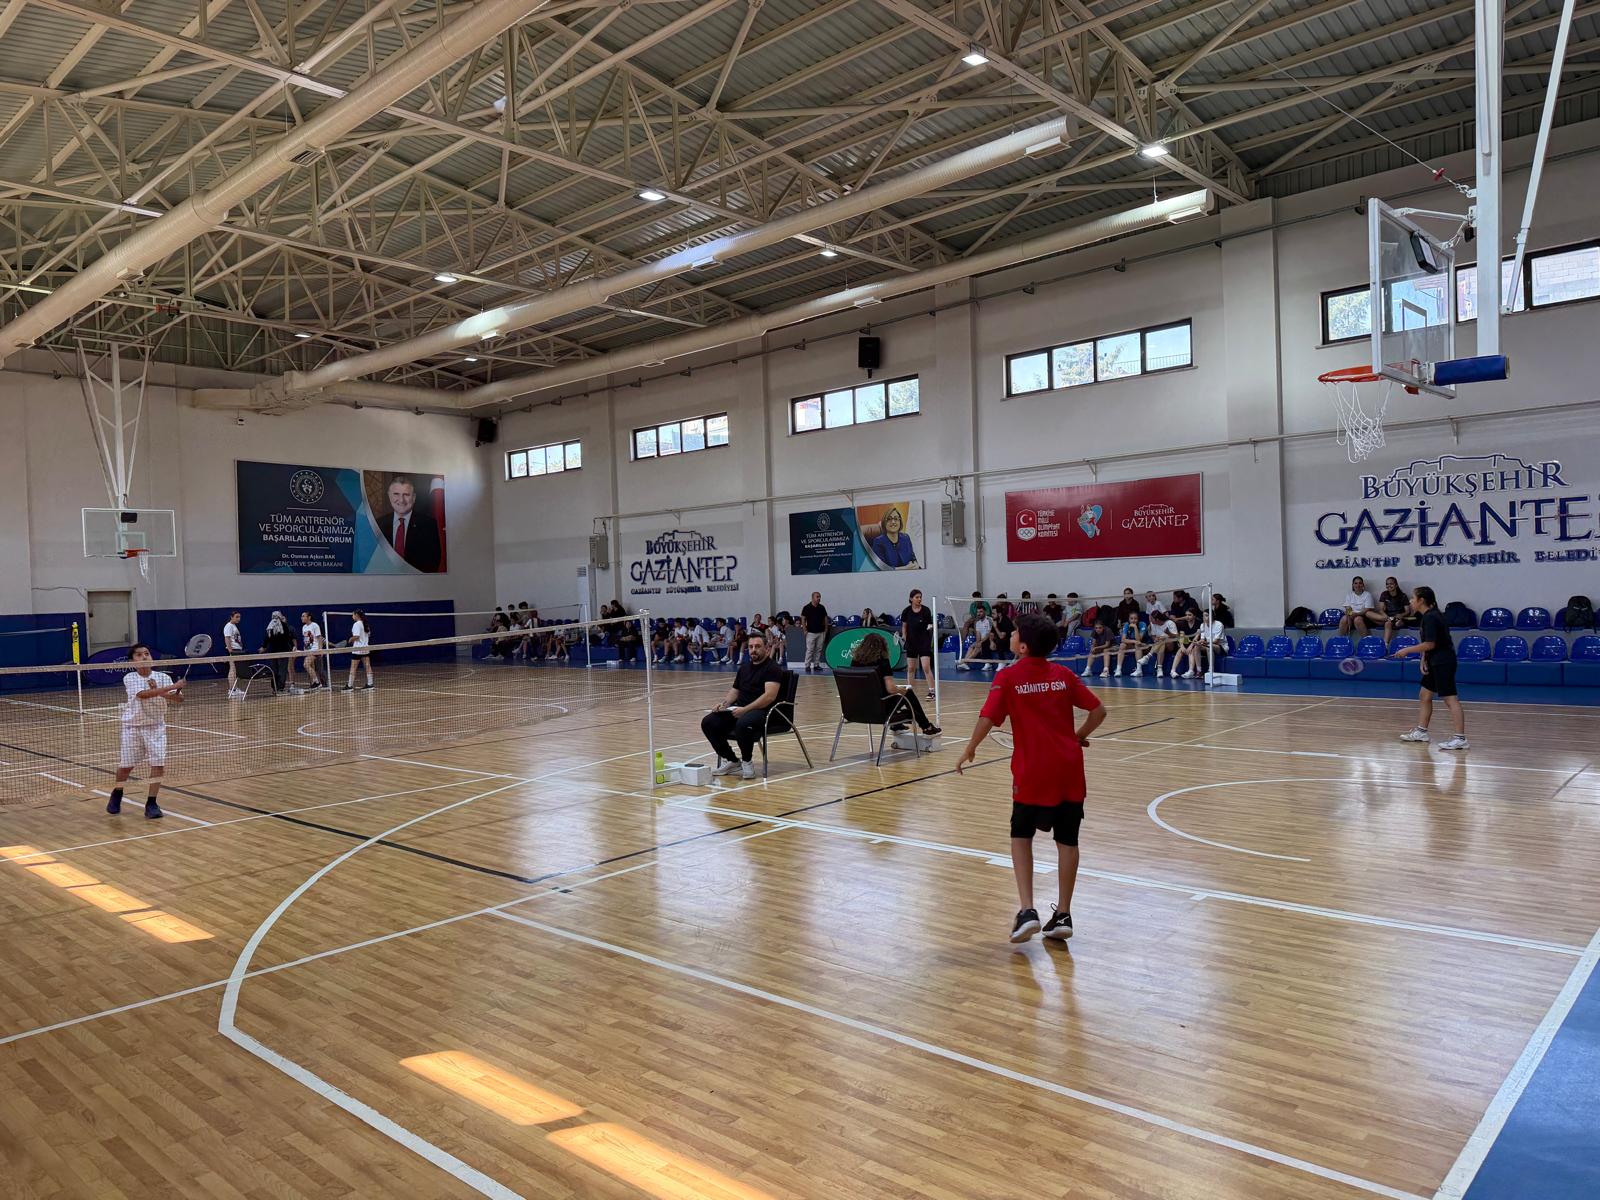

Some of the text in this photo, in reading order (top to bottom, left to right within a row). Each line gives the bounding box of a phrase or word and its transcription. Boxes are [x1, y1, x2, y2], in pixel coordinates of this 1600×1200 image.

[1361, 461, 1569, 498] BÜYÜKŞEHİR
[258, 523, 355, 535] VE SPORCULARIMIZA
[270, 513, 345, 526] TÜM ANTRENÖR
[1315, 496, 1600, 551] GAZİANTE
[262, 534, 352, 544] BAŞARILAR DİLİYORUM
[645, 535, 718, 556] BÜYÜKŞEHİR
[1315, 547, 1600, 569] GAZİANTEP BÜYÜKŞEHİR BELEDİ
[630, 554, 738, 585] GAZİANTEP
